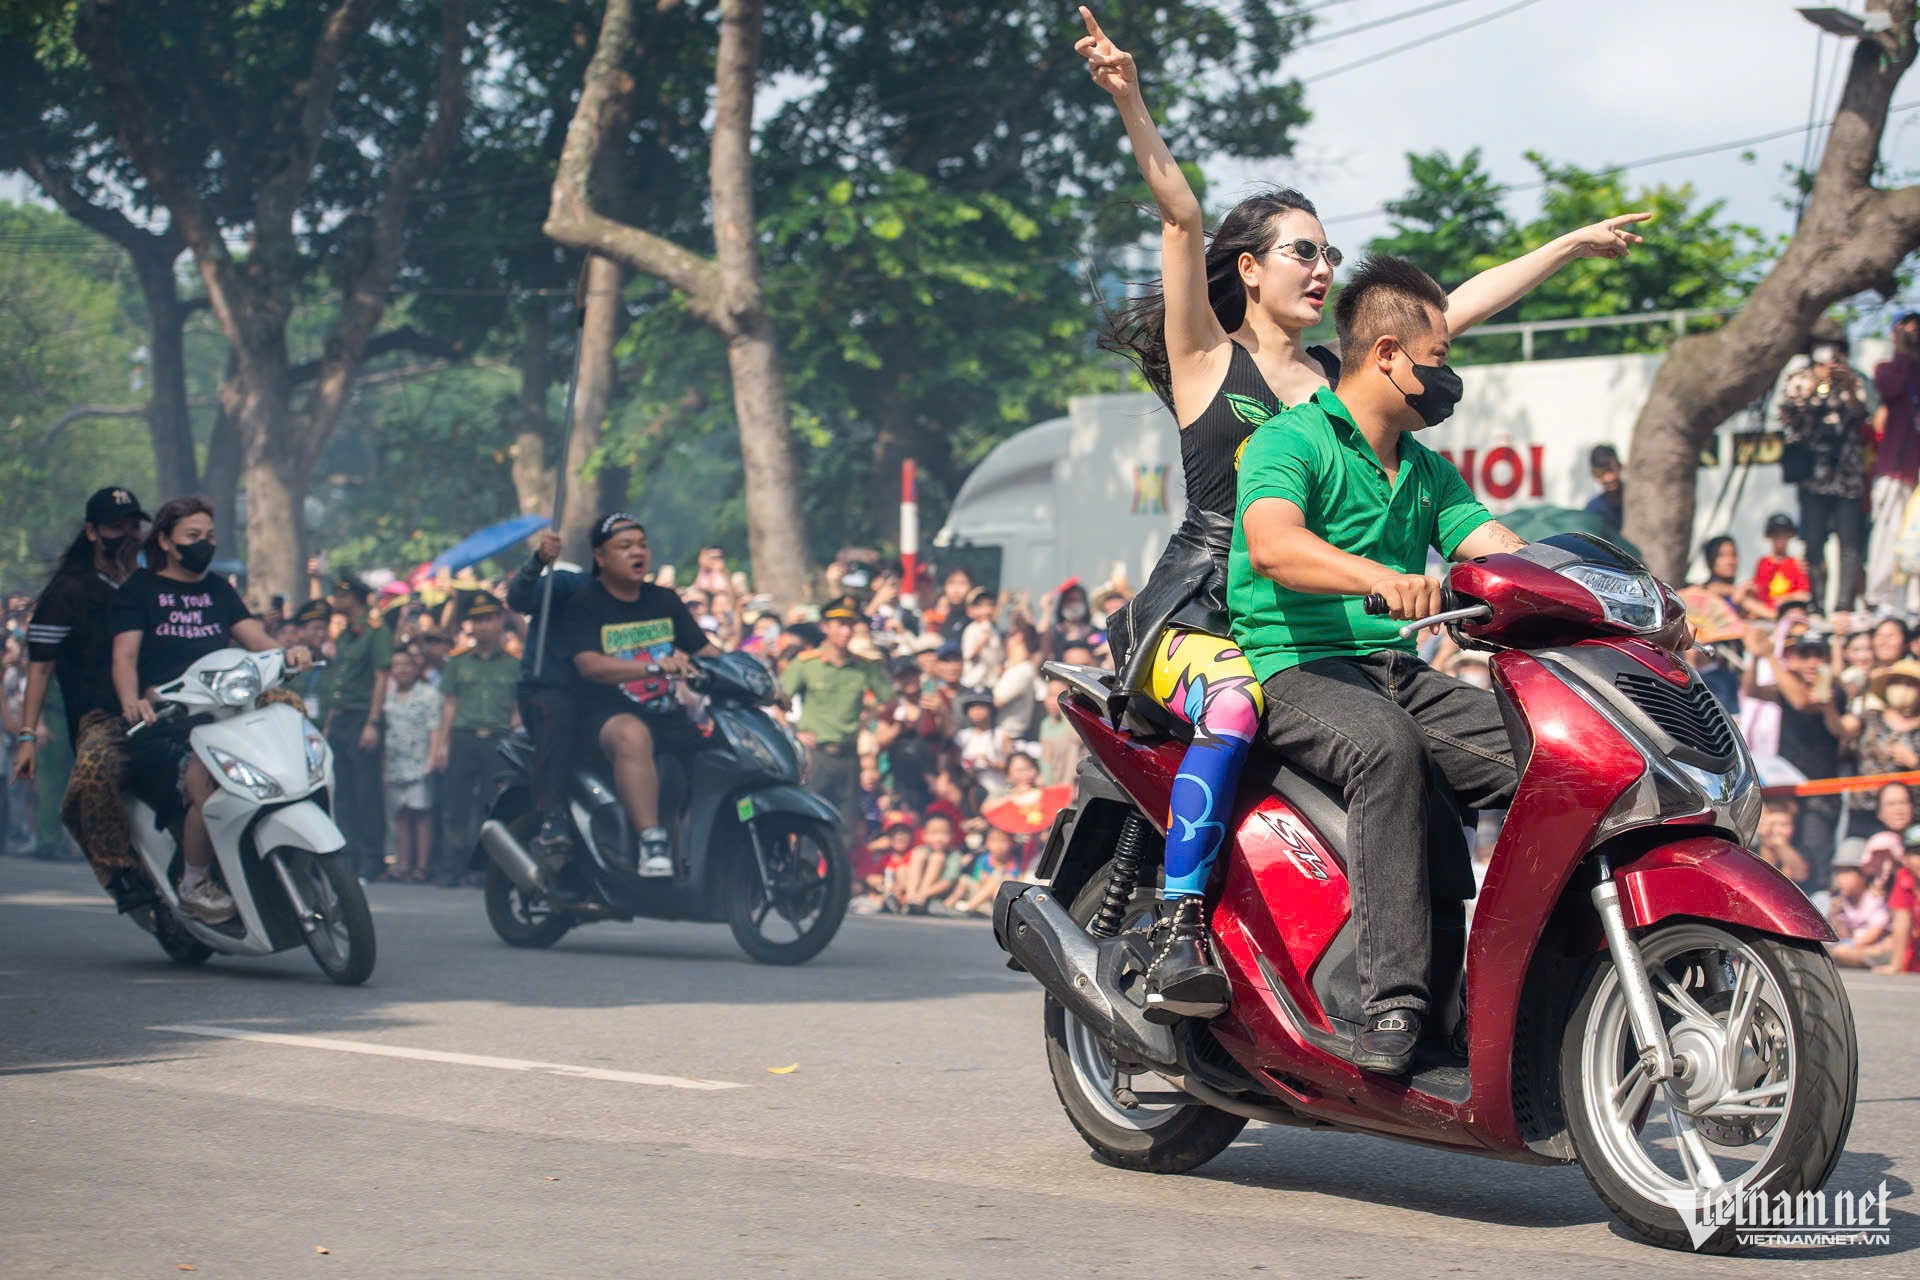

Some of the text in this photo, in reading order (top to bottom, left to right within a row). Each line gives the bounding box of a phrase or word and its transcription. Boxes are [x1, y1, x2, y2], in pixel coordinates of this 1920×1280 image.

[158, 592, 213, 609] BE YOUR
[169, 610, 202, 625] OWN
[156, 623, 221, 639] CELEBRITY
